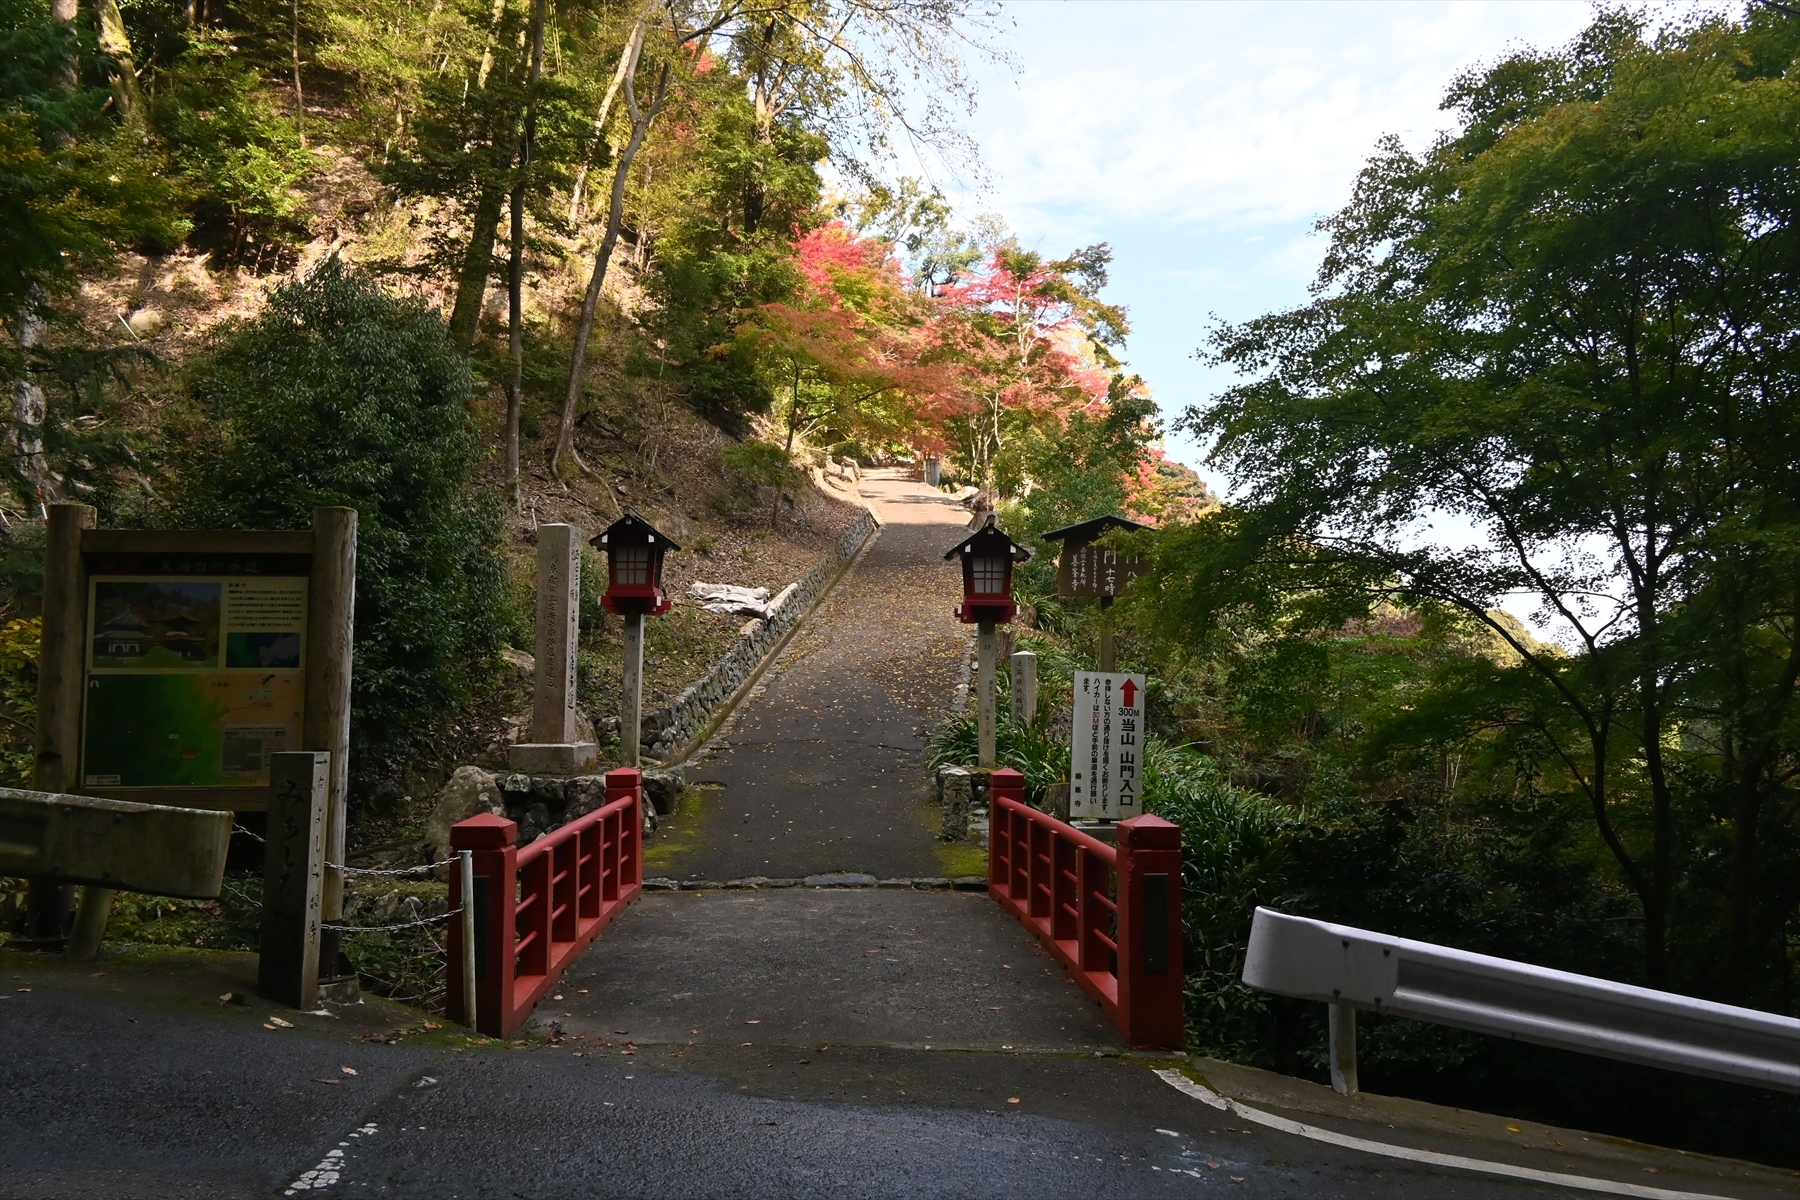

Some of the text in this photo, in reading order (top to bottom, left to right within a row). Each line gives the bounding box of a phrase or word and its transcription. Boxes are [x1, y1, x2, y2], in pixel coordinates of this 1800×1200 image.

[159, 561, 259, 573] 東海自然歩道
[1082, 677, 1090, 695] ます。
[1118, 707, 1140, 717] 300M
[1119, 718, 1135, 807] 当山 山門入口
[952, 788, 962, 815] 下馬
[274, 779, 305, 924] みちしるべ
